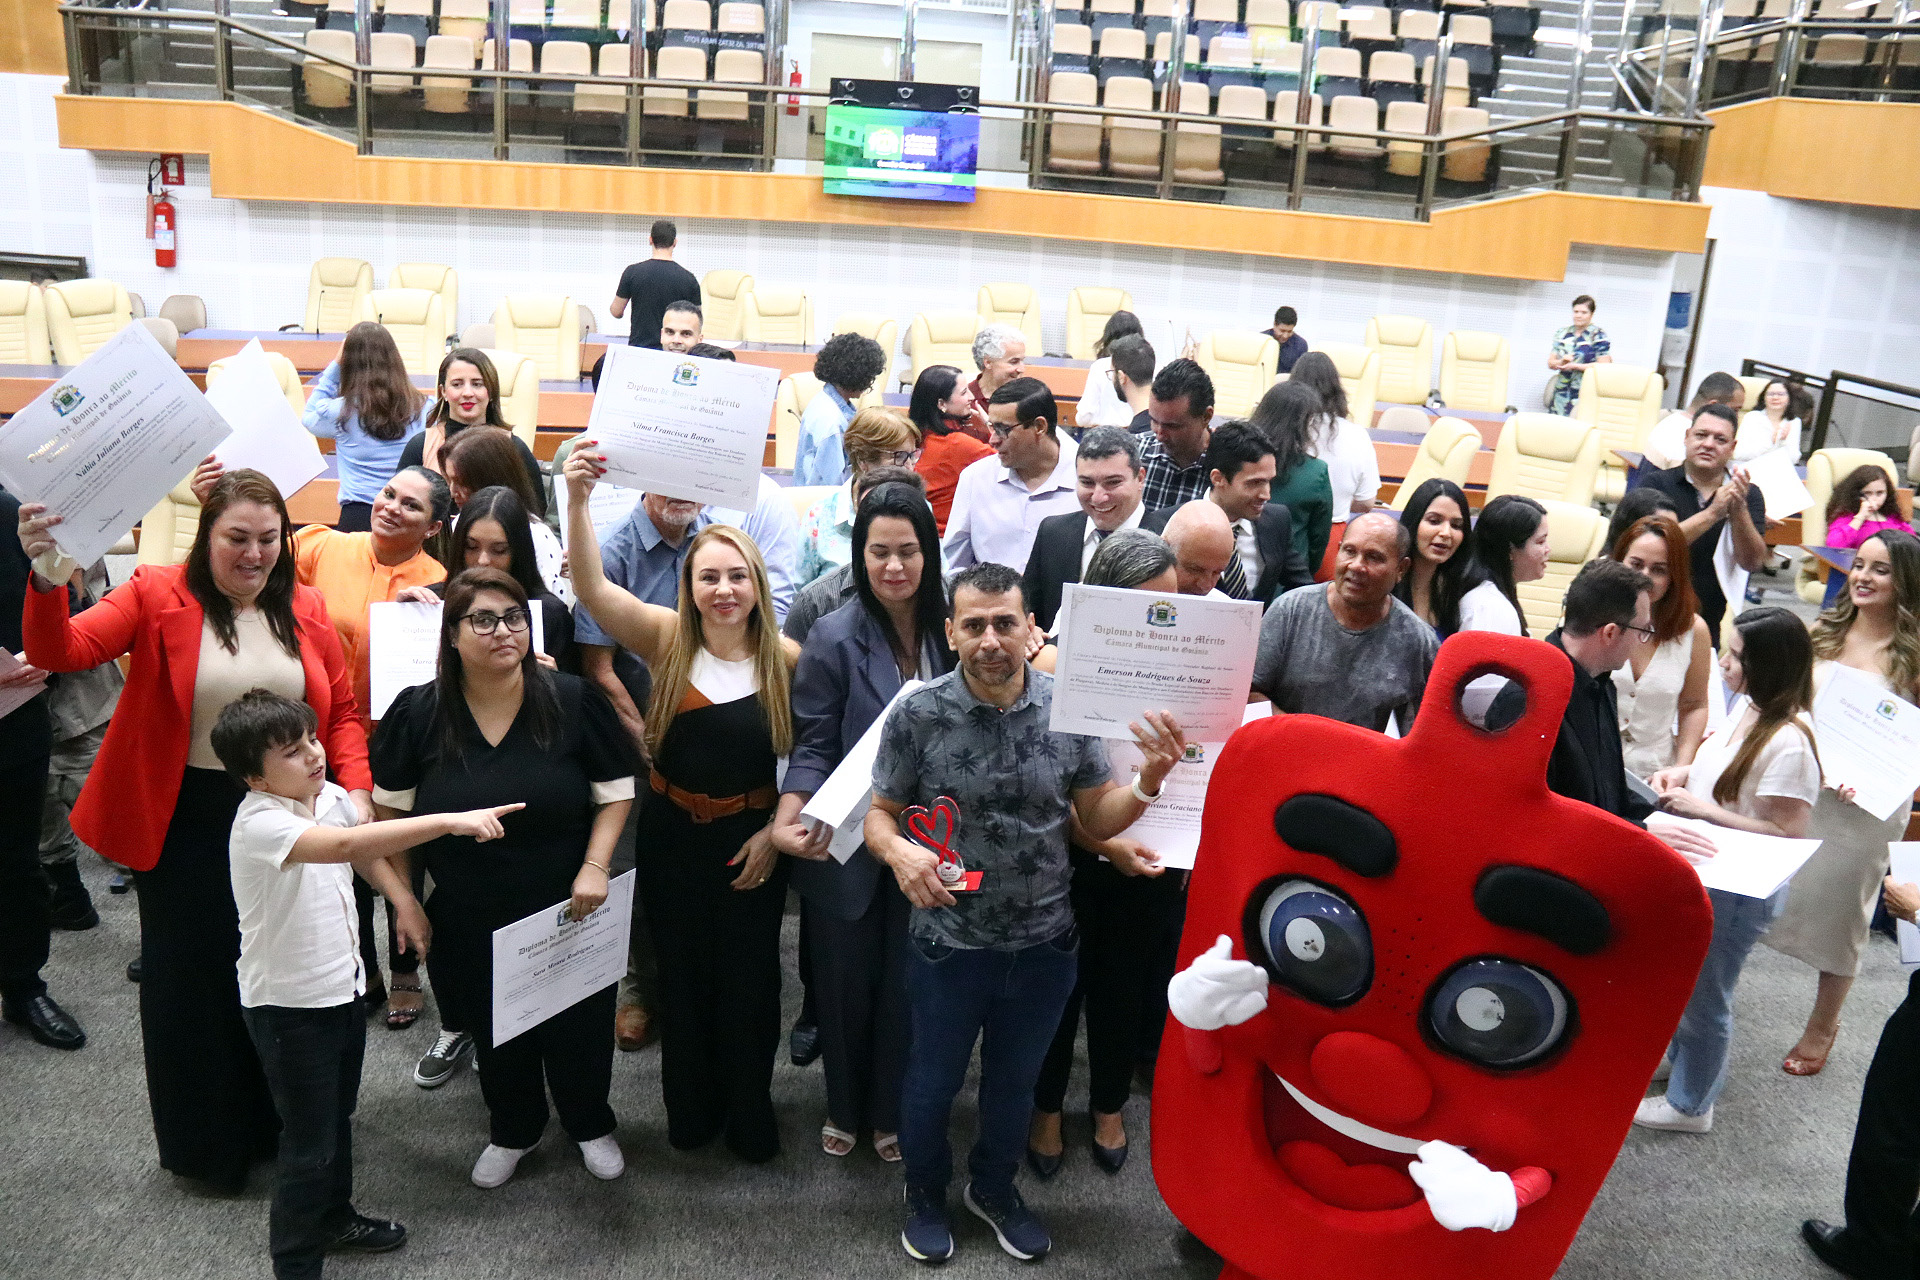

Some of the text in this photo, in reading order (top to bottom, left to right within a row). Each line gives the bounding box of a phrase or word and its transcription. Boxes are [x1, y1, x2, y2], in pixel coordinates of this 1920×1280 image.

[627, 381, 658, 393] Diploma
[711, 397, 740, 409] Mérito
[634, 395, 656, 403] Câmara
[699, 406, 724, 416] Goiânia
[27, 370, 137, 464] Diploma de Honra ao Mérito
[72, 416, 100, 440] Municipal
[108, 389, 132, 410] Goiânia
[631, 422, 715, 443] Nilma Francisca Borges
[75, 460, 96, 480] Núbia
[96, 438, 121, 462] Juliana
[121, 417, 144, 439] Borges
[1093, 625, 1132, 637] Diploma
[1136, 630, 1145, 638] de
[1149, 631, 1178, 641] Honra
[1194, 635, 1225, 645] Mérito
[1105, 639, 1132, 647] Câmara
[1134, 642, 1170, 651] Municipal
[1181, 647, 1208, 655] Goiânia
[1097, 666, 1133, 677] Emerson
[1134, 671, 1175, 681] Rodrigues
[1187, 676, 1211, 684] Souza
[1169, 777, 1201, 786] Municipal
[1180, 766, 1207, 776] Honra
[1169, 802, 1203, 812] Graciano
[518, 939, 547, 956] Diploma
[559, 923, 578, 936] Honra
[589, 907, 610, 922] Mérito
[528, 947, 547, 959] Câmara
[532, 968, 545, 978] Sara
[567, 944, 594, 960] Rodrigues
